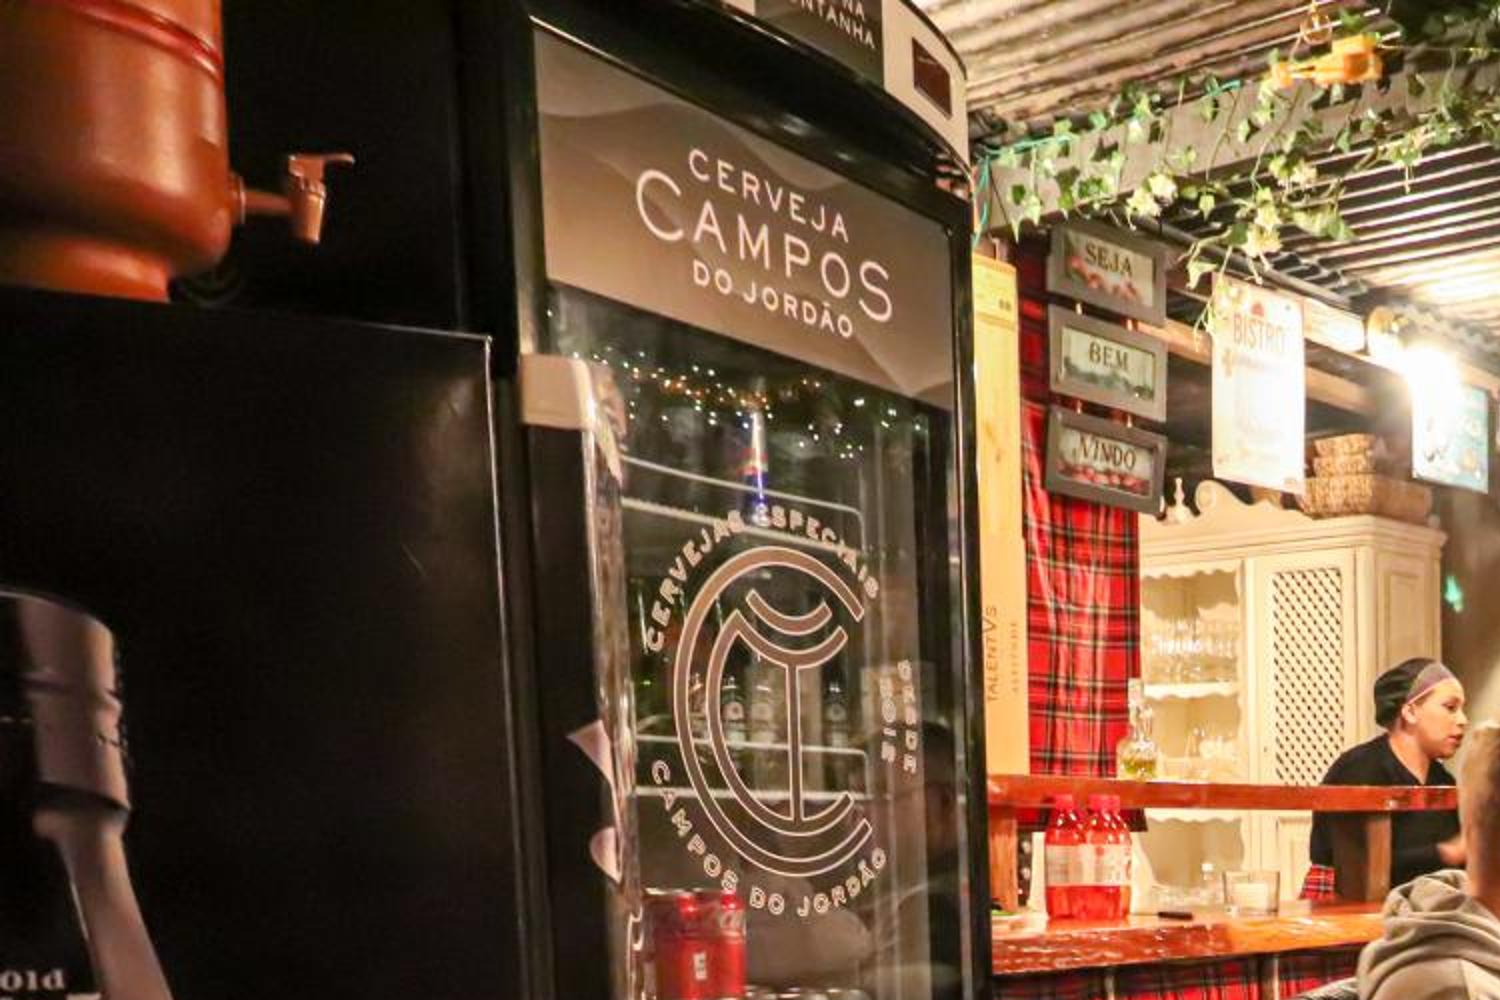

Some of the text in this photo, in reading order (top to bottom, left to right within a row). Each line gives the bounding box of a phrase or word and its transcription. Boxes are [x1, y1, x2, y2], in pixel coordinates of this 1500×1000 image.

[789, 0, 876, 49] NTANHA
[688, 148, 849, 243] CERVEJA
[636, 169, 893, 322] CAMPOS
[1085, 241, 1133, 276] SEJA
[693, 260, 854, 338] DO JORDÃO
[1089, 341, 1129, 372] BEM
[1080, 433, 1137, 471] VINDO
[645, 510, 745, 653] CERVEJAS
[651, 759, 888, 918] CAMPOS DO JORDÃO
[0, 968, 66, 991] Old
